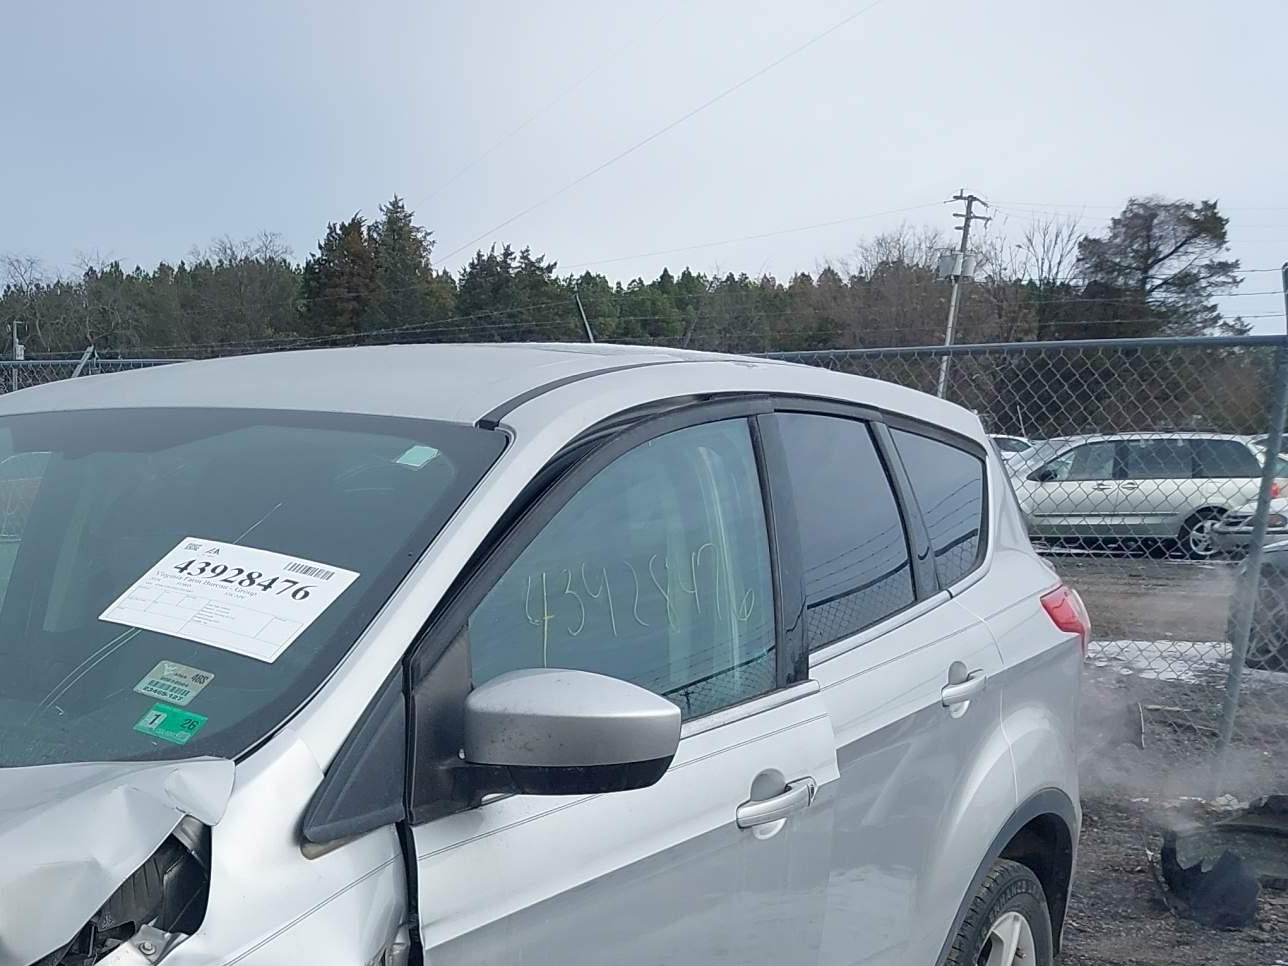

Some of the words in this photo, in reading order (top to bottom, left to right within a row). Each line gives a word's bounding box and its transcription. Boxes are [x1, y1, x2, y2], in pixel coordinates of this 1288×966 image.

[173, 558, 319, 601] 43928476
[148, 713, 161, 726] 1
[180, 718, 199, 731] 26
